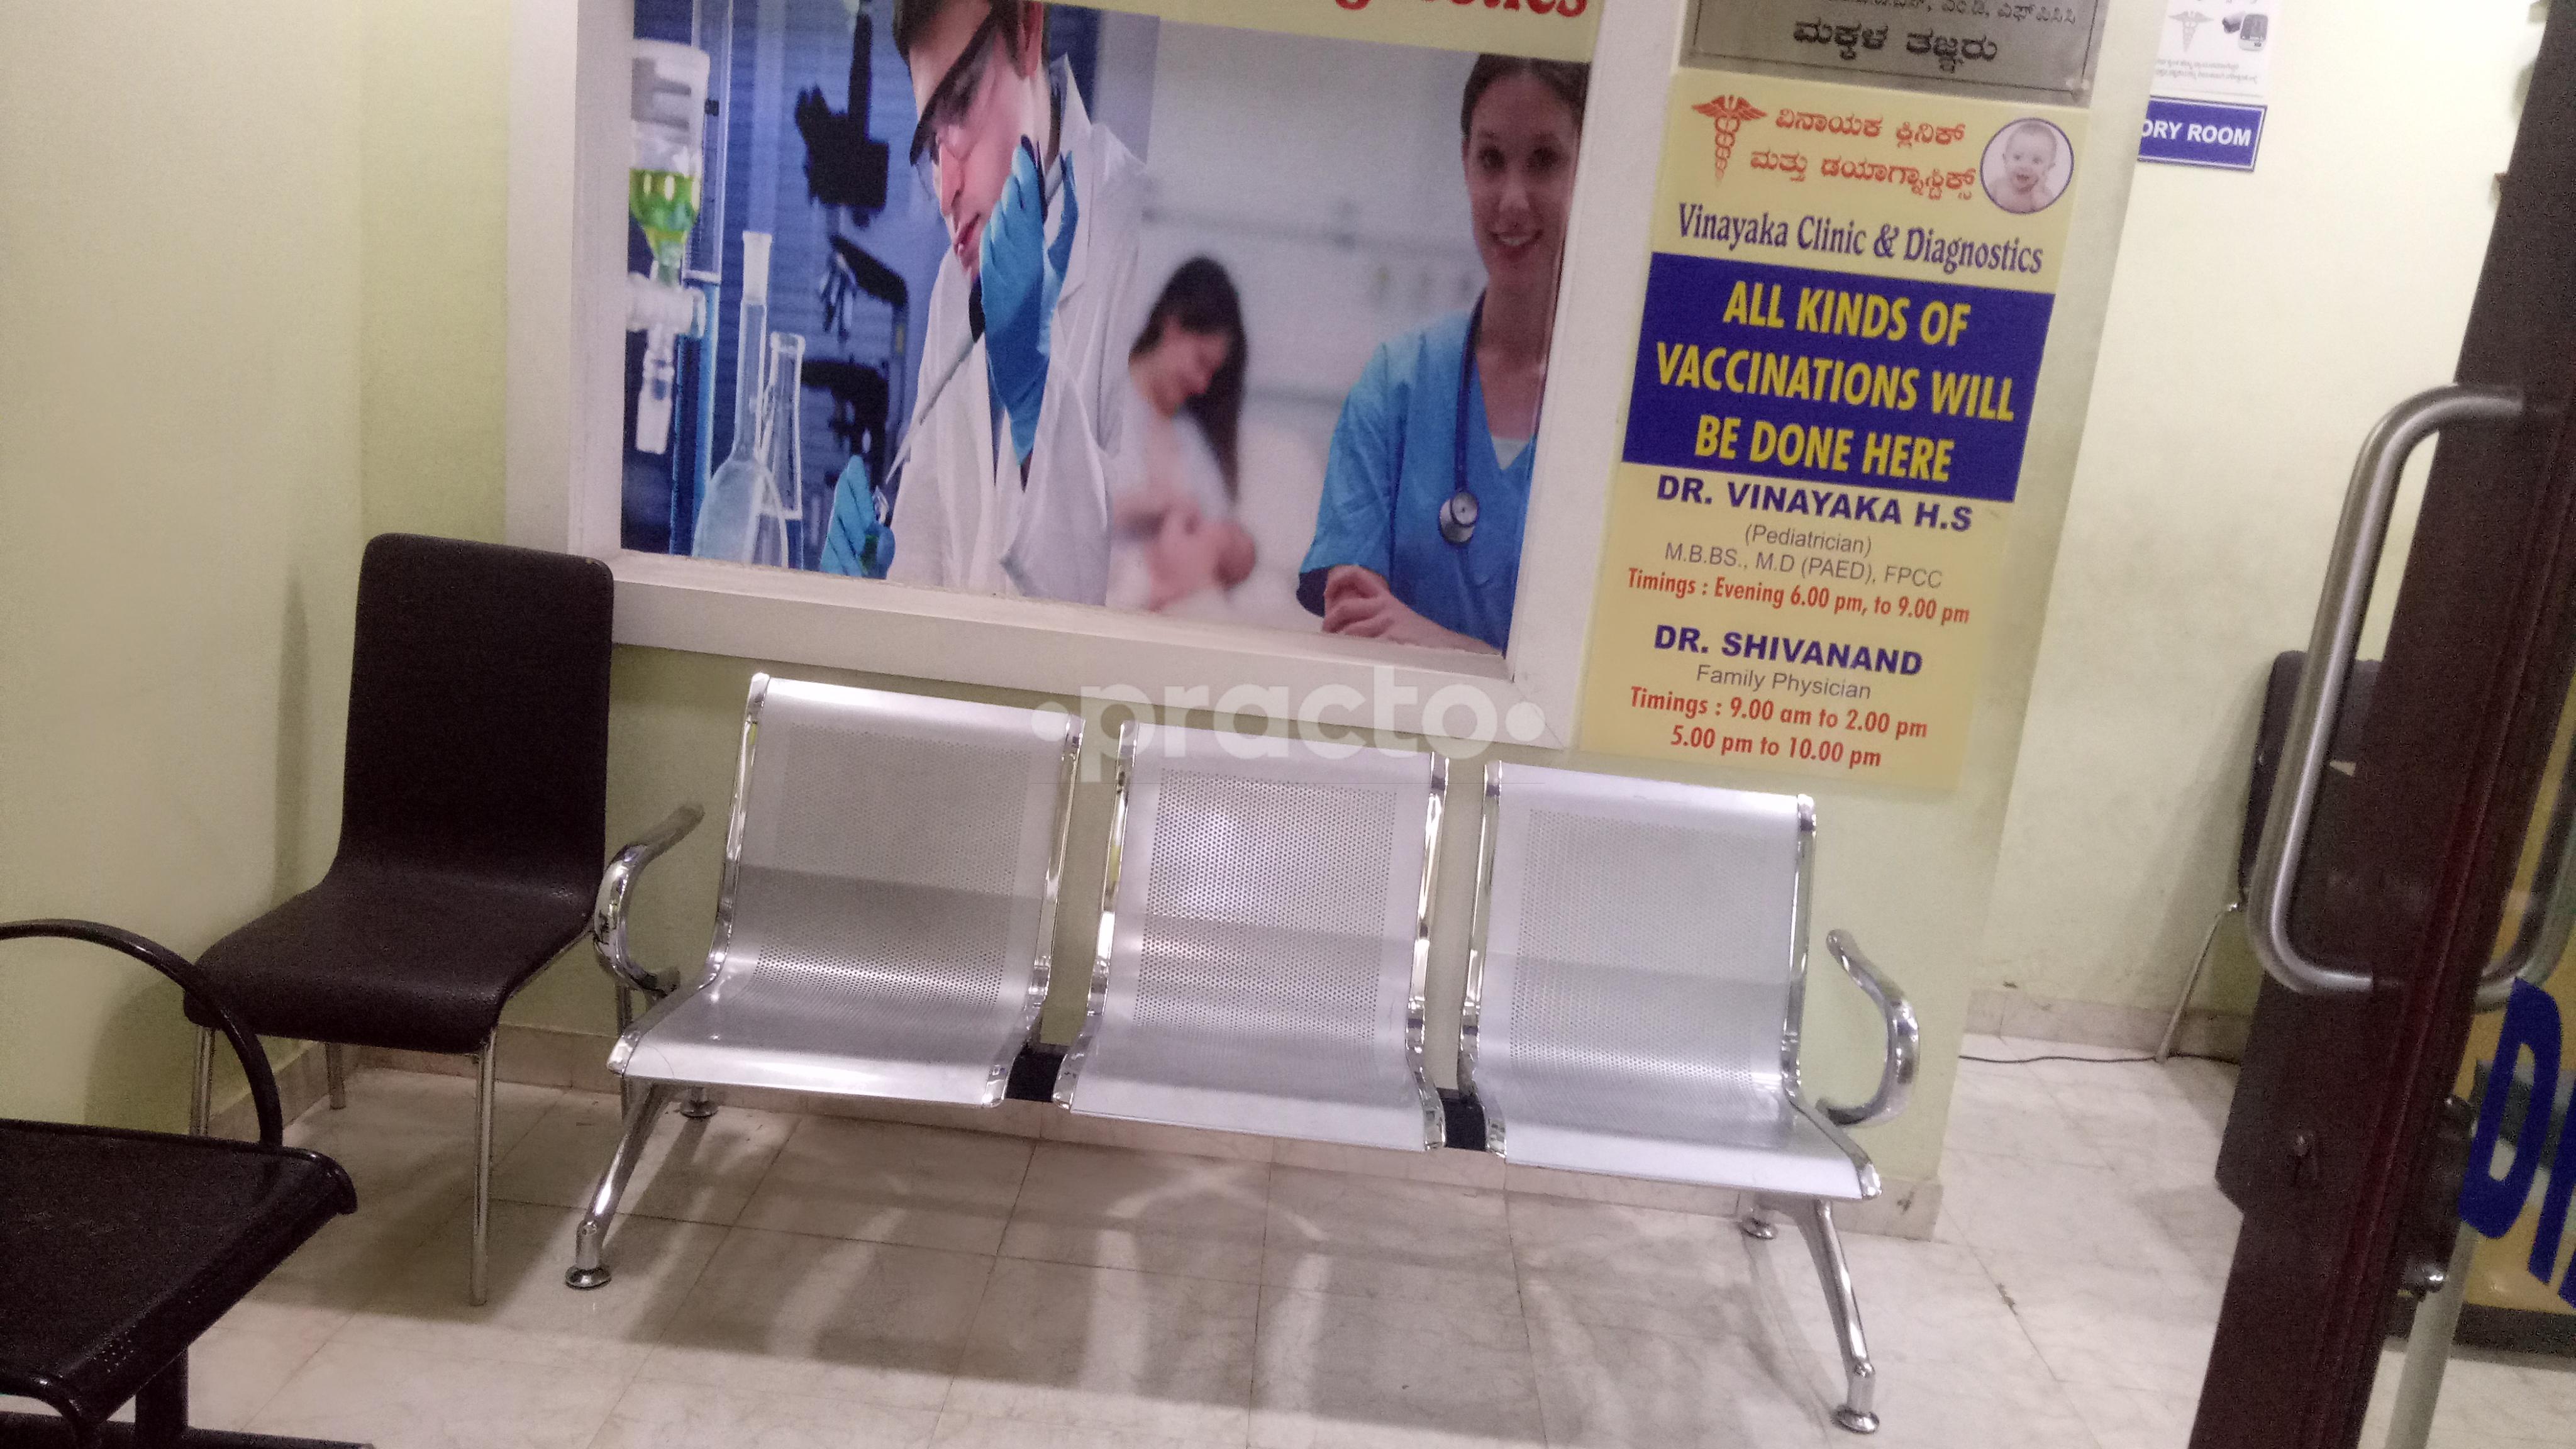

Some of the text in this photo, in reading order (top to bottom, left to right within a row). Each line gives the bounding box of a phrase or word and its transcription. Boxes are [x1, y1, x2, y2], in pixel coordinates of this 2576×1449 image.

[1793, 18, 1889, 60] ಮಕ್ಕಳ
[1775, 108, 1966, 148] ವಿನಾಯಕ ಕ್ಲಿನಿಕ್
[2187, 123, 2252, 147] ROOM
[1750, 148, 1808, 182] ಮತ್ತು
[1679, 203, 2043, 275] Vinayaka Clinic & Diagnostics
[1723, 280, 1972, 346] ALL KINDS OF
[1656, 342, 2014, 421] VACCINATIONS WILL
[1694, 414, 1955, 482] BE DONE HERE
[1656, 474, 1974, 533] DR. VINAYAKA H.S
[1744, 524, 1874, 558] (Pediatrician)
[1755, 552, 1796, 573] M.D
[1884, 565, 1944, 589] FPCC
[1628, 567, 1971, 626] Timings : Evening 6.00 pm, to 9.00 pm
[1653, 625, 1923, 675] DR. SHIVANAND
[1696, 664, 1872, 700] Family Physician
[1630, 686, 1928, 740] Timings : 9.00 am to 2.00 pm
[1670, 724, 1882, 769] 5.00 pm to 10.00 pm
